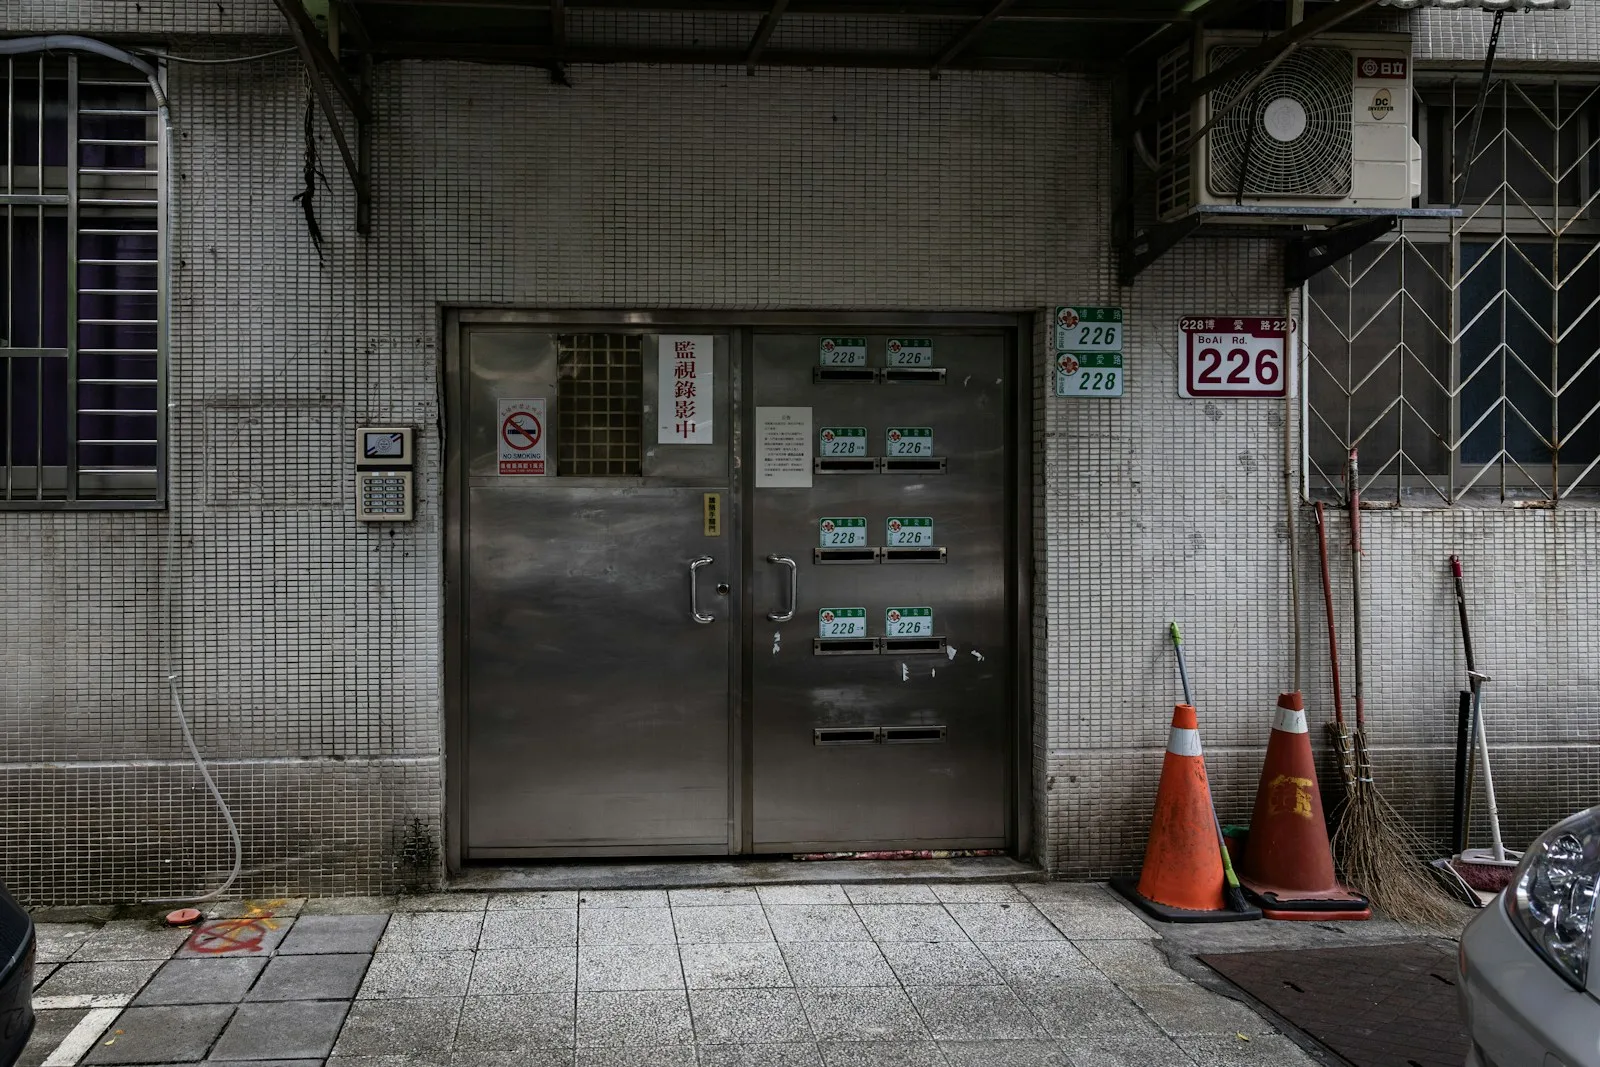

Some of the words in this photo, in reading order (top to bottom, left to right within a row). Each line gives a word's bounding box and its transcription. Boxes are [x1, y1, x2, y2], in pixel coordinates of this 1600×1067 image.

[1381, 62, 1404, 75] 日立
[1375, 98, 1388, 106] DC
[1182, 319, 1204, 330] 228
[1205, 319, 1270, 331] 博愛路
[1079, 327, 1115, 345] 226
[1232, 336, 1248, 345] Rd.
[832, 352, 855, 363] 228
[898, 352, 922, 364] 226
[1198, 348, 1279, 385] 226
[1079, 372, 1116, 390] 228
[674, 341, 696, 439] 監視錄影中
[832, 442, 855, 454] 228
[898, 442, 922, 454] 226
[832, 532, 855, 544] 228
[898, 532, 922, 543] 226
[831, 623, 855, 634] 228
[897, 622, 921, 633] 226
